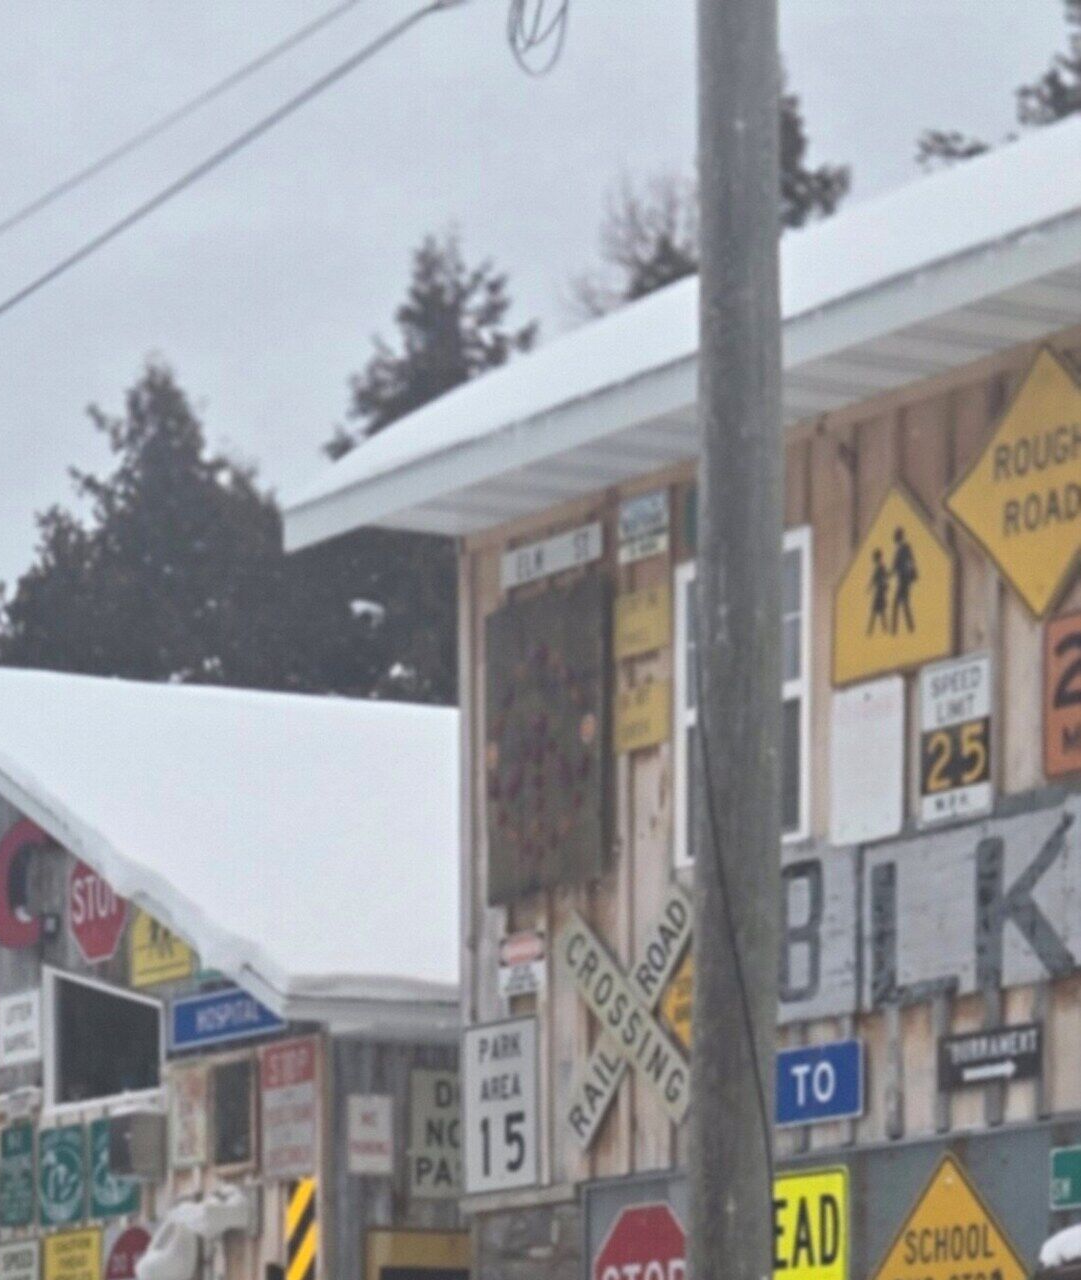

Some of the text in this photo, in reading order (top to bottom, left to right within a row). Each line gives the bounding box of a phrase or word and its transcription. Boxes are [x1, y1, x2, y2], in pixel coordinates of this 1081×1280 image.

[1003, 482, 1081, 537] ROAD
[929, 664, 982, 699] SPEED
[935, 692, 976, 726] LIMIT
[926, 722, 989, 794] 25
[565, 932, 685, 1104] CROSSING
[568, 899, 687, 1138] RAIL ROAD
[478, 1031, 520, 1060] PARK
[480, 1069, 521, 1100] AREA
[791, 1061, 836, 1106] TO
[480, 1110, 526, 1177] 15
[904, 1223, 994, 1266] SCHOOL
